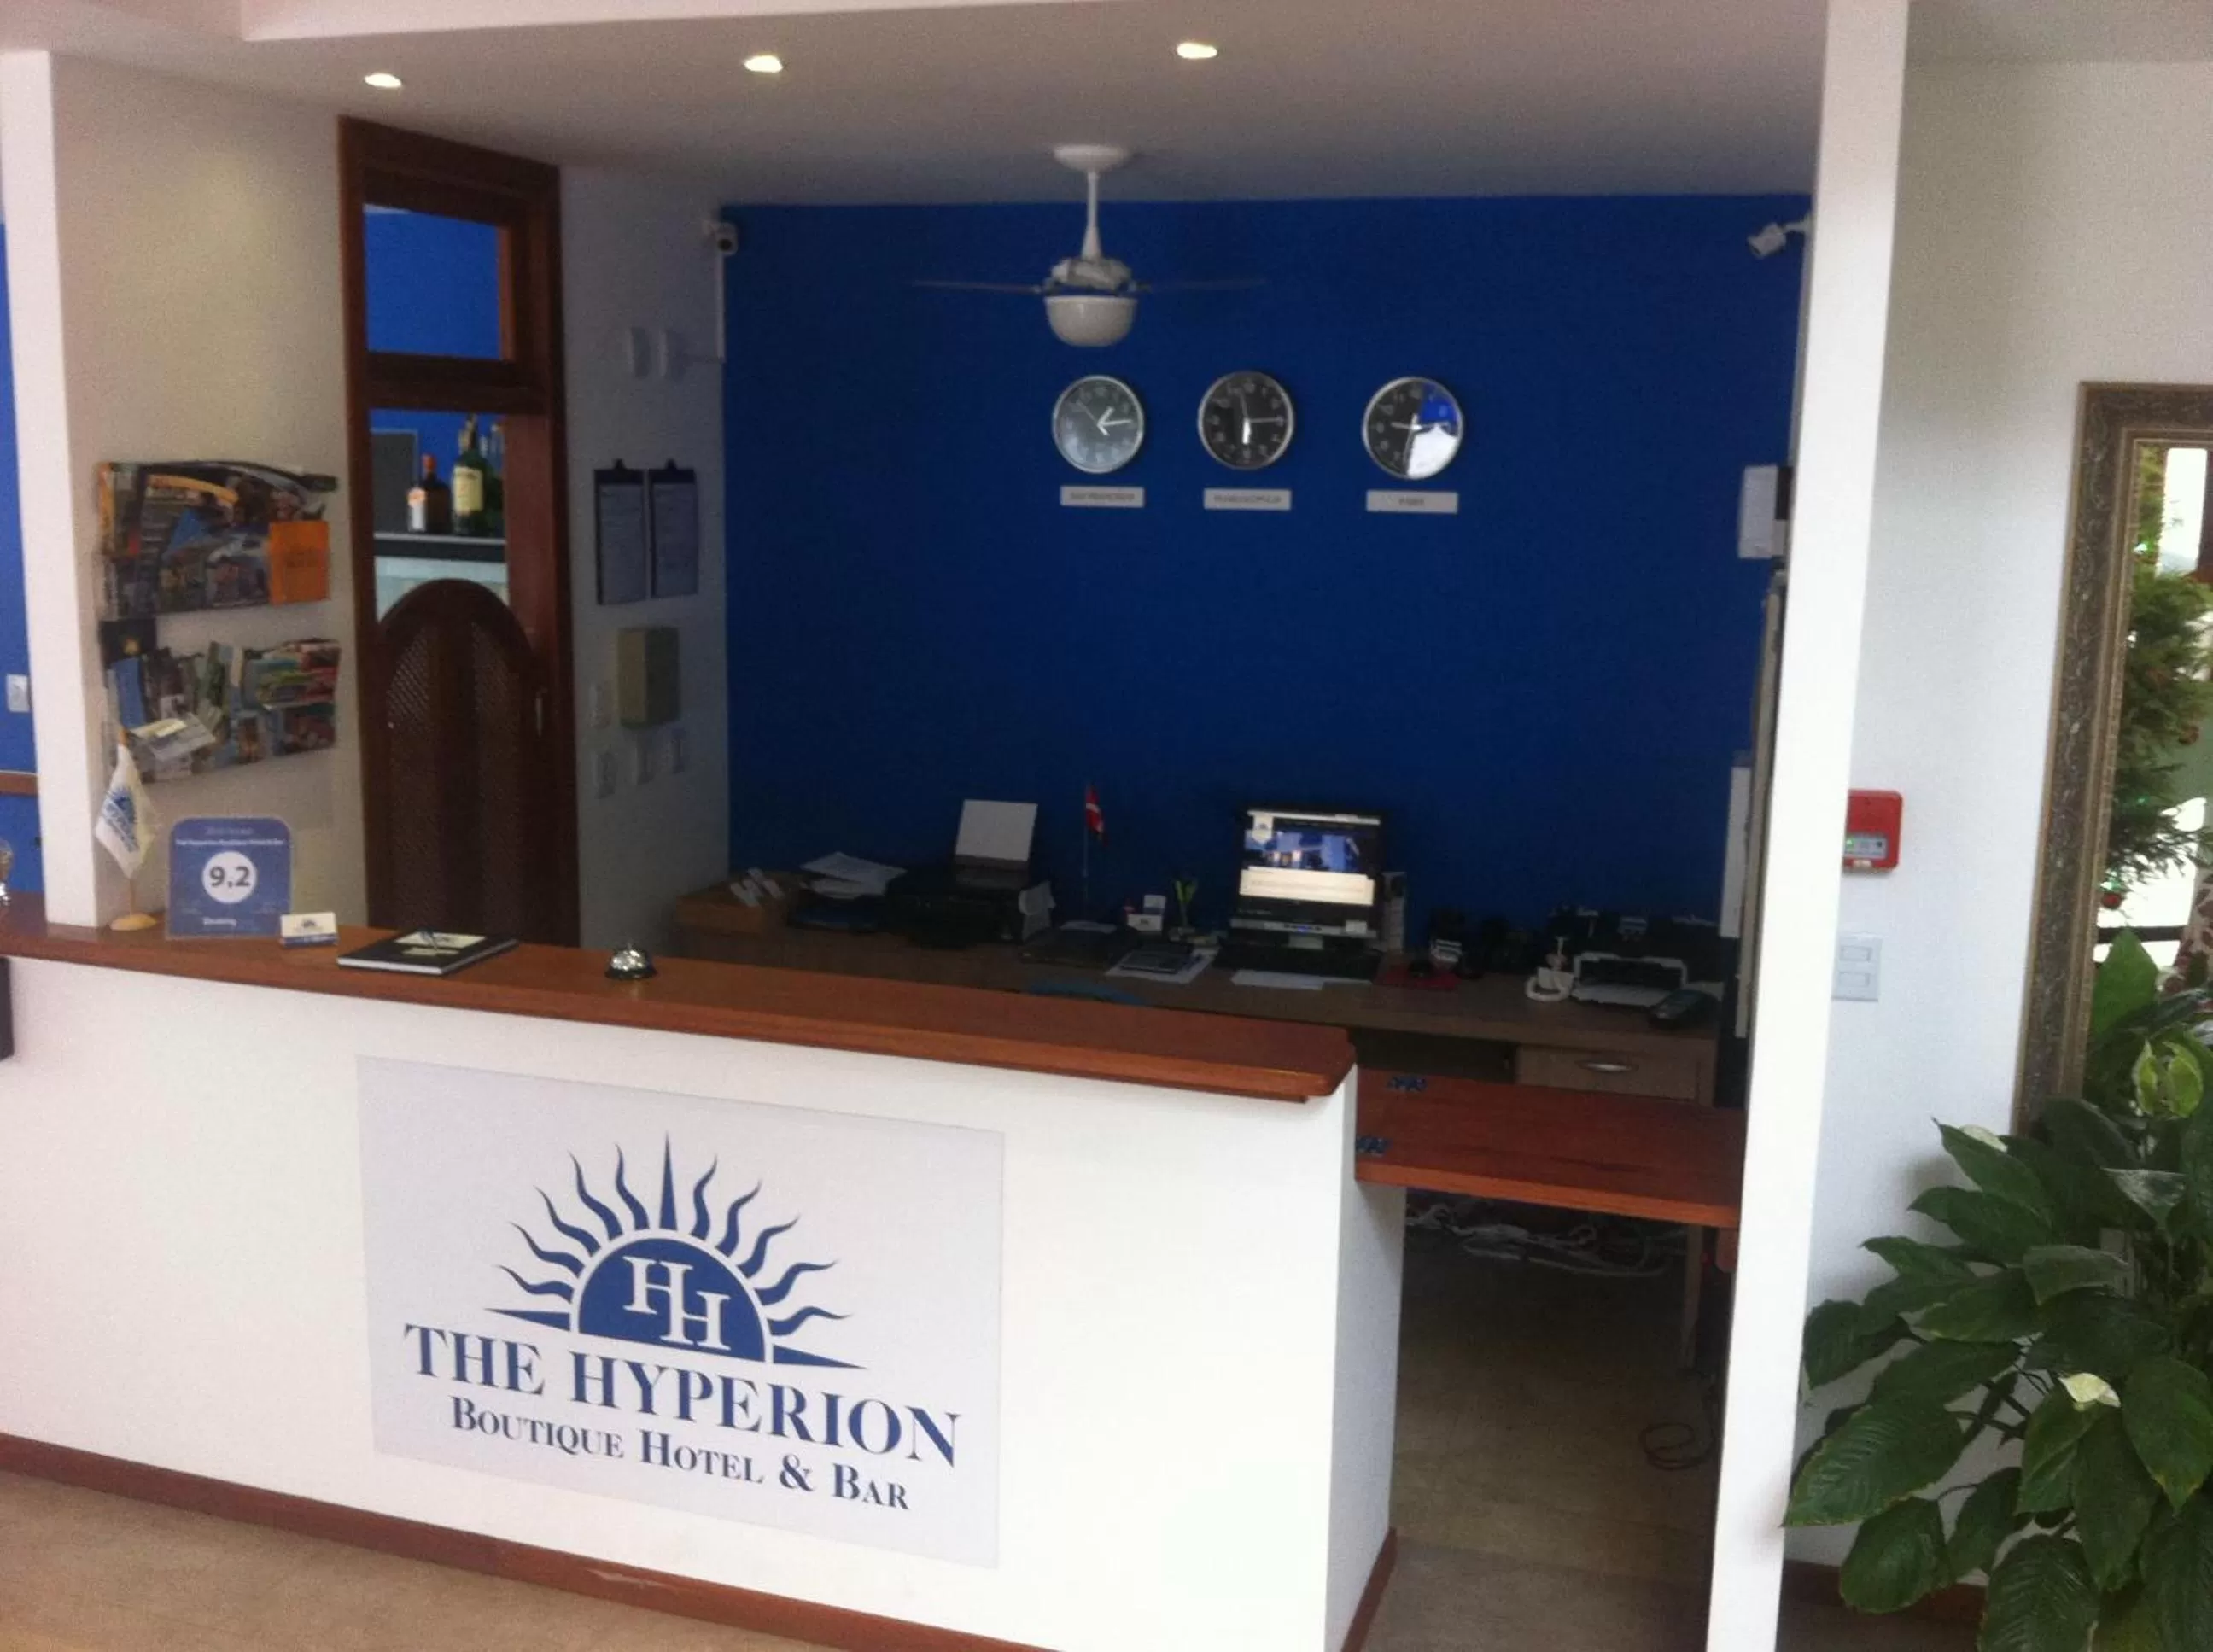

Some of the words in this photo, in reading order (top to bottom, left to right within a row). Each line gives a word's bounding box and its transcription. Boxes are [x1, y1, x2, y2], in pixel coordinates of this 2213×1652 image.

[403, 1322, 546, 1396] THE
[569, 1350, 961, 1468] HYPERION
[448, 1395, 625, 1458] BOUTIQUE
[639, 1427, 764, 1484] HOTEL
[778, 1453, 815, 1493] &
[831, 1462, 910, 1511] BAR
